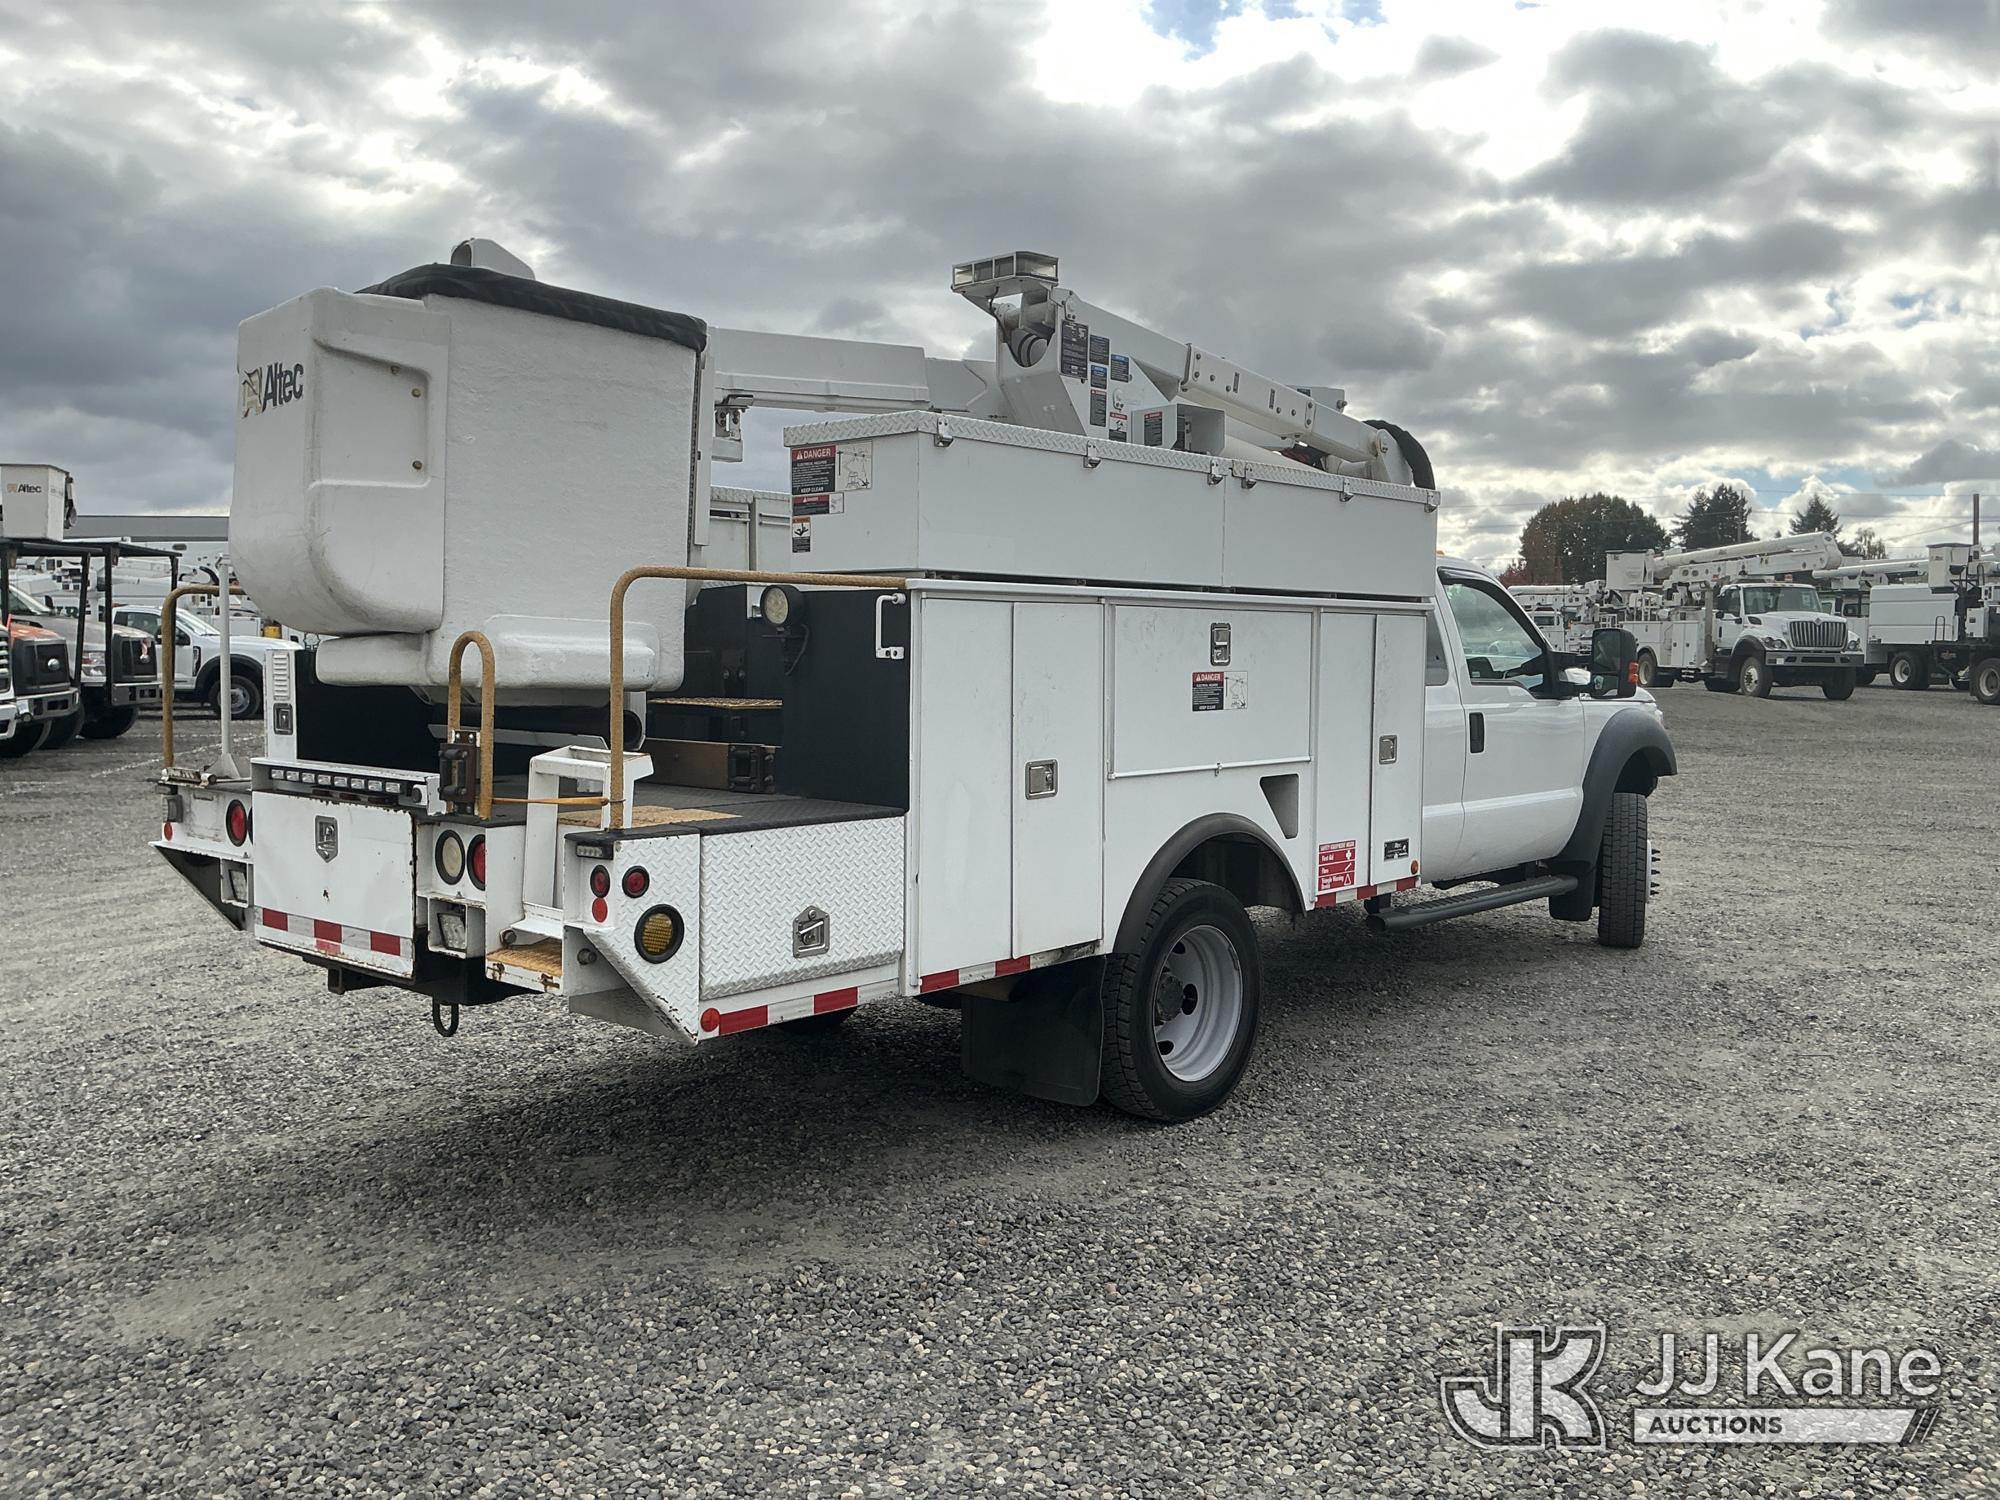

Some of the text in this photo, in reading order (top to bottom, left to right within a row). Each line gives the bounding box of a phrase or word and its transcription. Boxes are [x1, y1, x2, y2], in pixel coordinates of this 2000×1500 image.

[262, 362, 304, 413] Altec
[803, 448, 831, 459] DANGER
[17, 483, 42, 493] Altec
